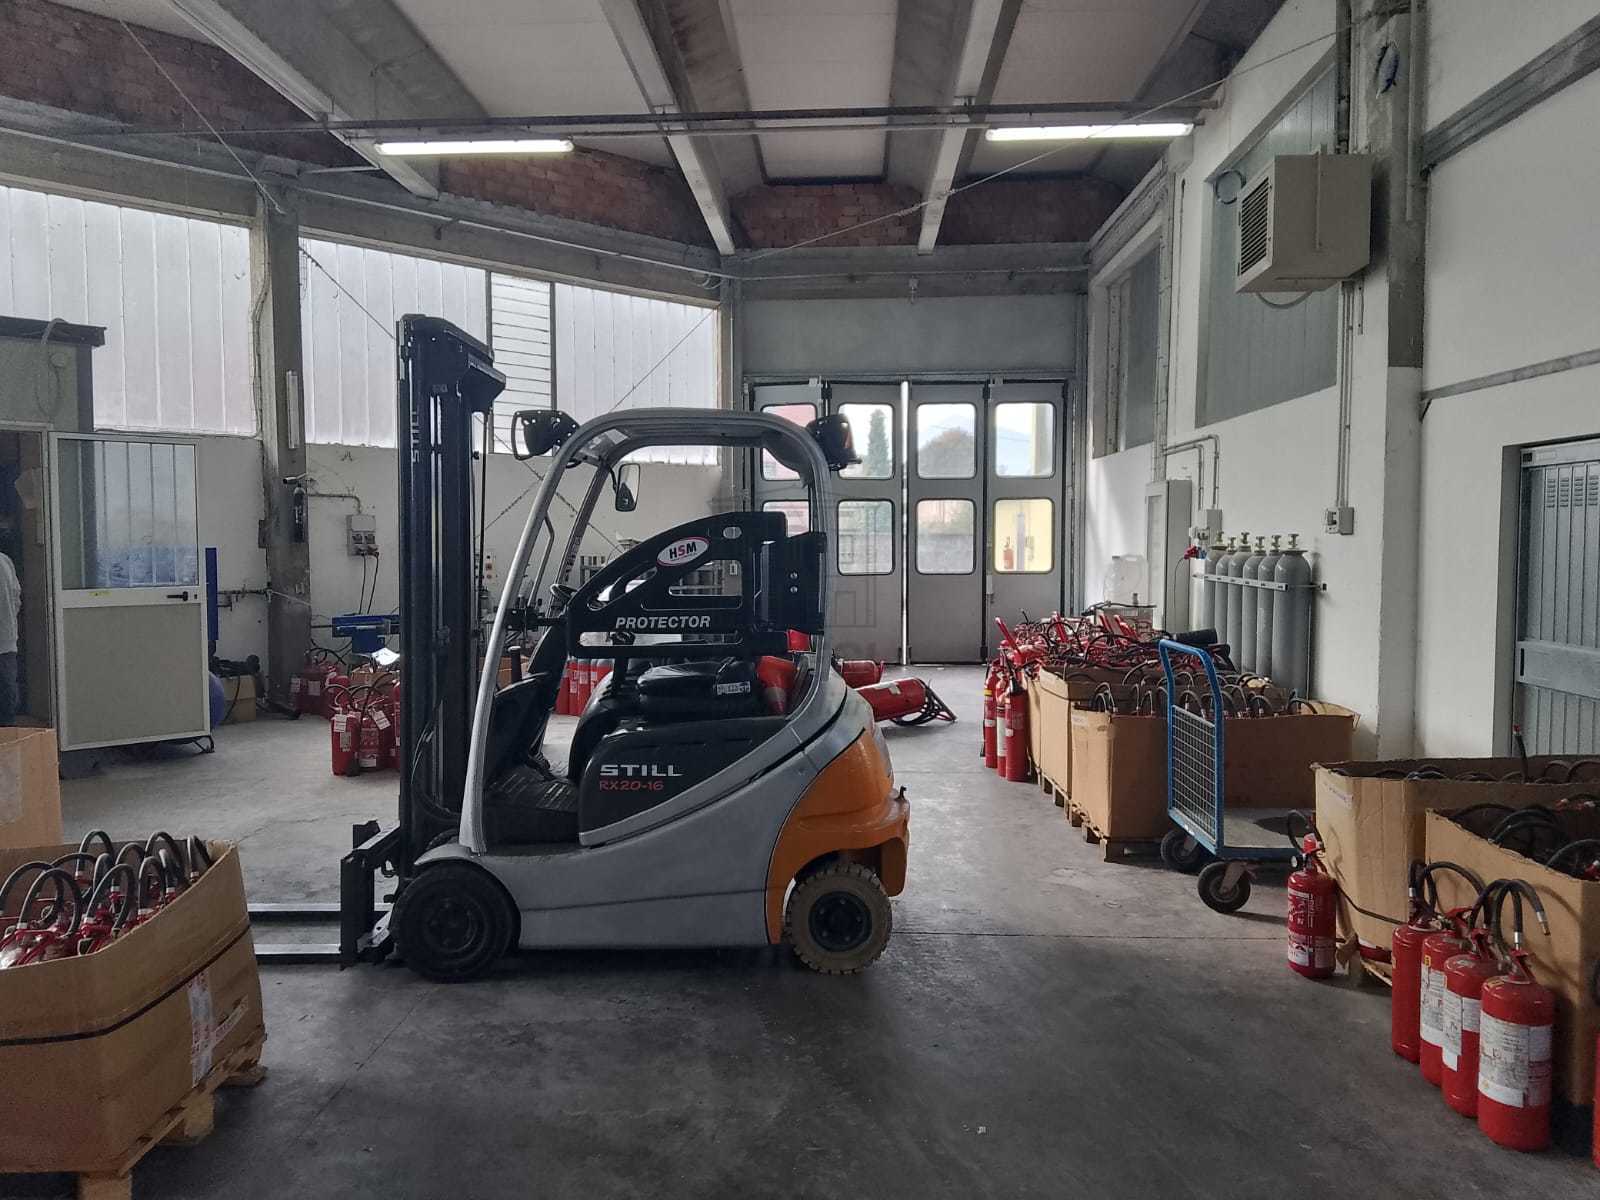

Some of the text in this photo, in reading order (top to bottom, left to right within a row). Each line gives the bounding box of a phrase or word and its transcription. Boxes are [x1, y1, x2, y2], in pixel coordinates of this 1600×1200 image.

[669, 541, 697, 559] HSM
[615, 615, 711, 629] PROTECTOR
[600, 764, 684, 777] STILL
[600, 780, 664, 791] RX20-16
